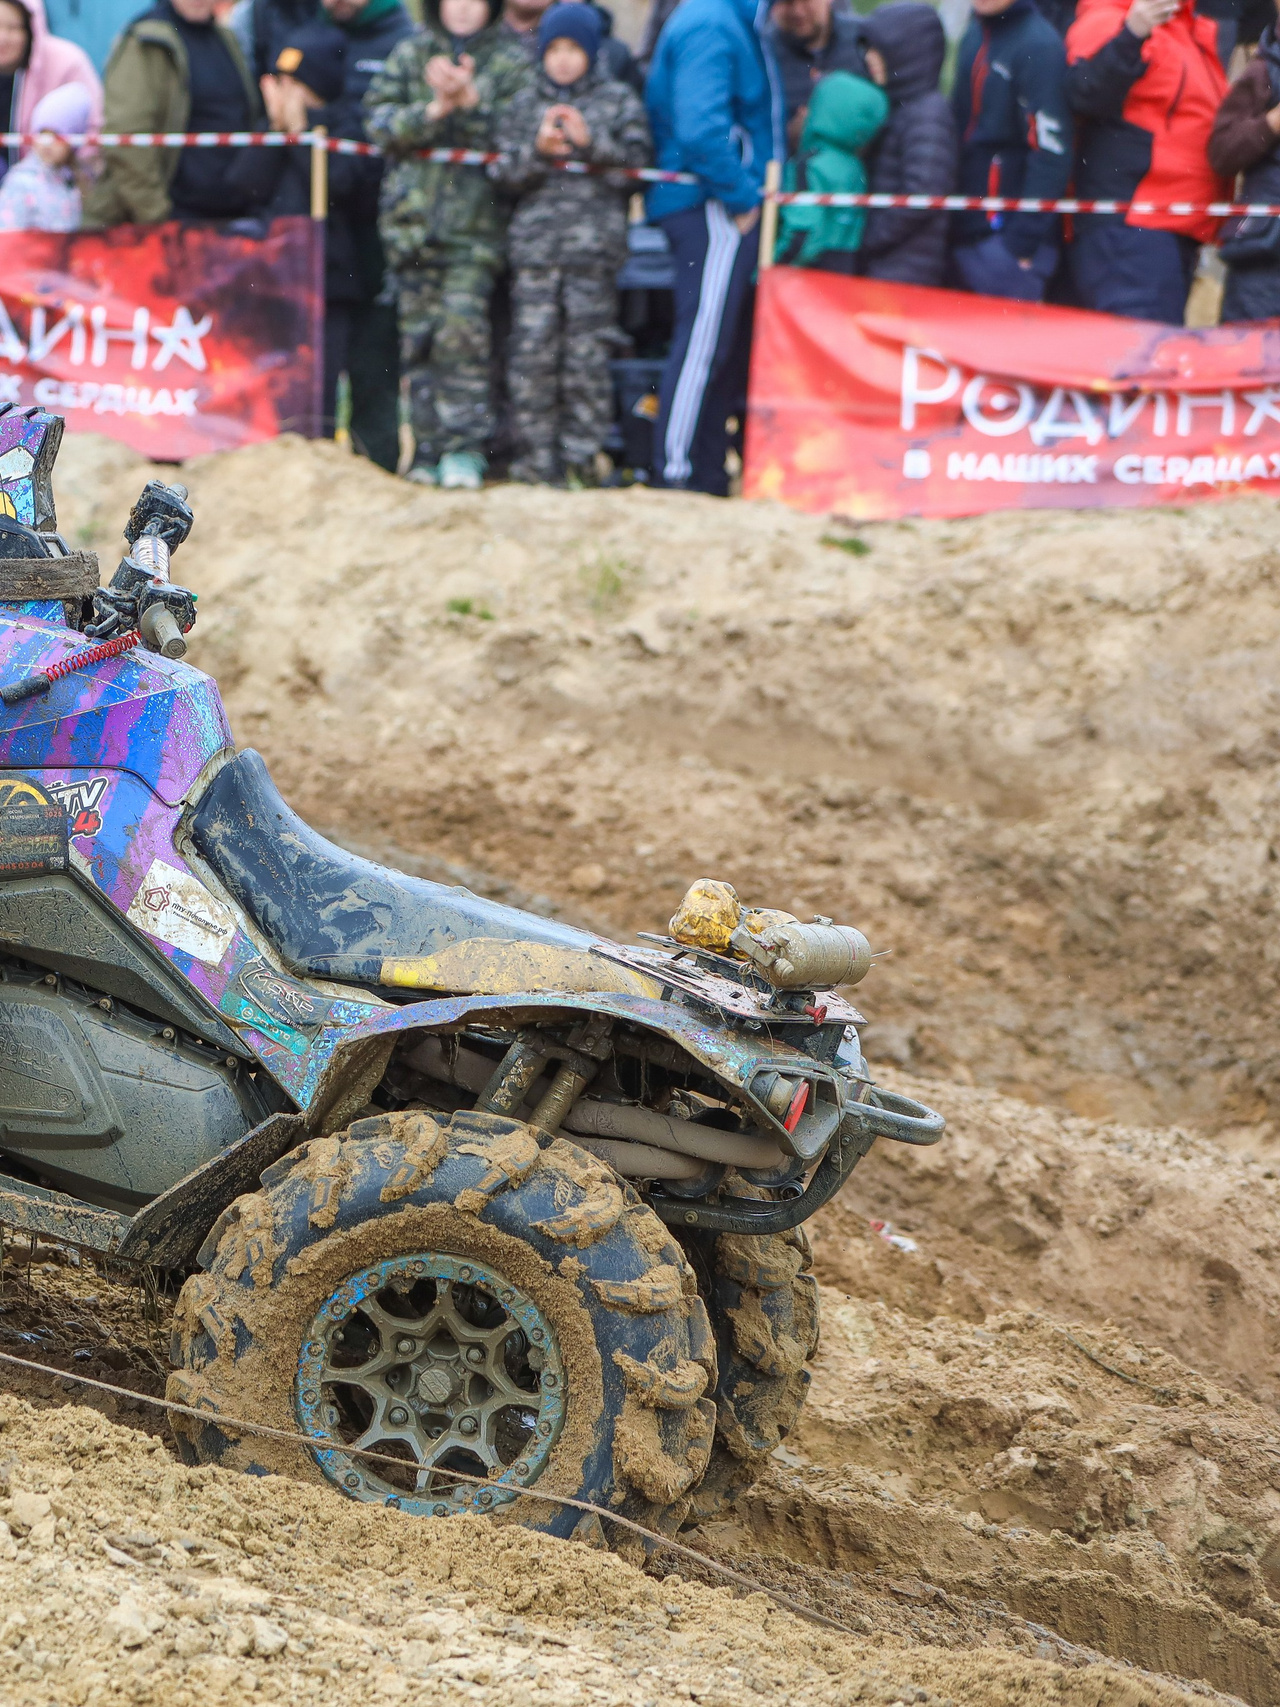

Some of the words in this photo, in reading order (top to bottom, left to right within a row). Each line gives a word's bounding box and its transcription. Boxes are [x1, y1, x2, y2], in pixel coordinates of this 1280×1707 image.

[33, 377, 199, 416] СЕРДЦАХ
[903, 449, 930, 480] В
[947, 452, 1097, 484] НАШИХ
[51, 777, 108, 813] TV
[253, 1015, 291, 1041] CFOTO
